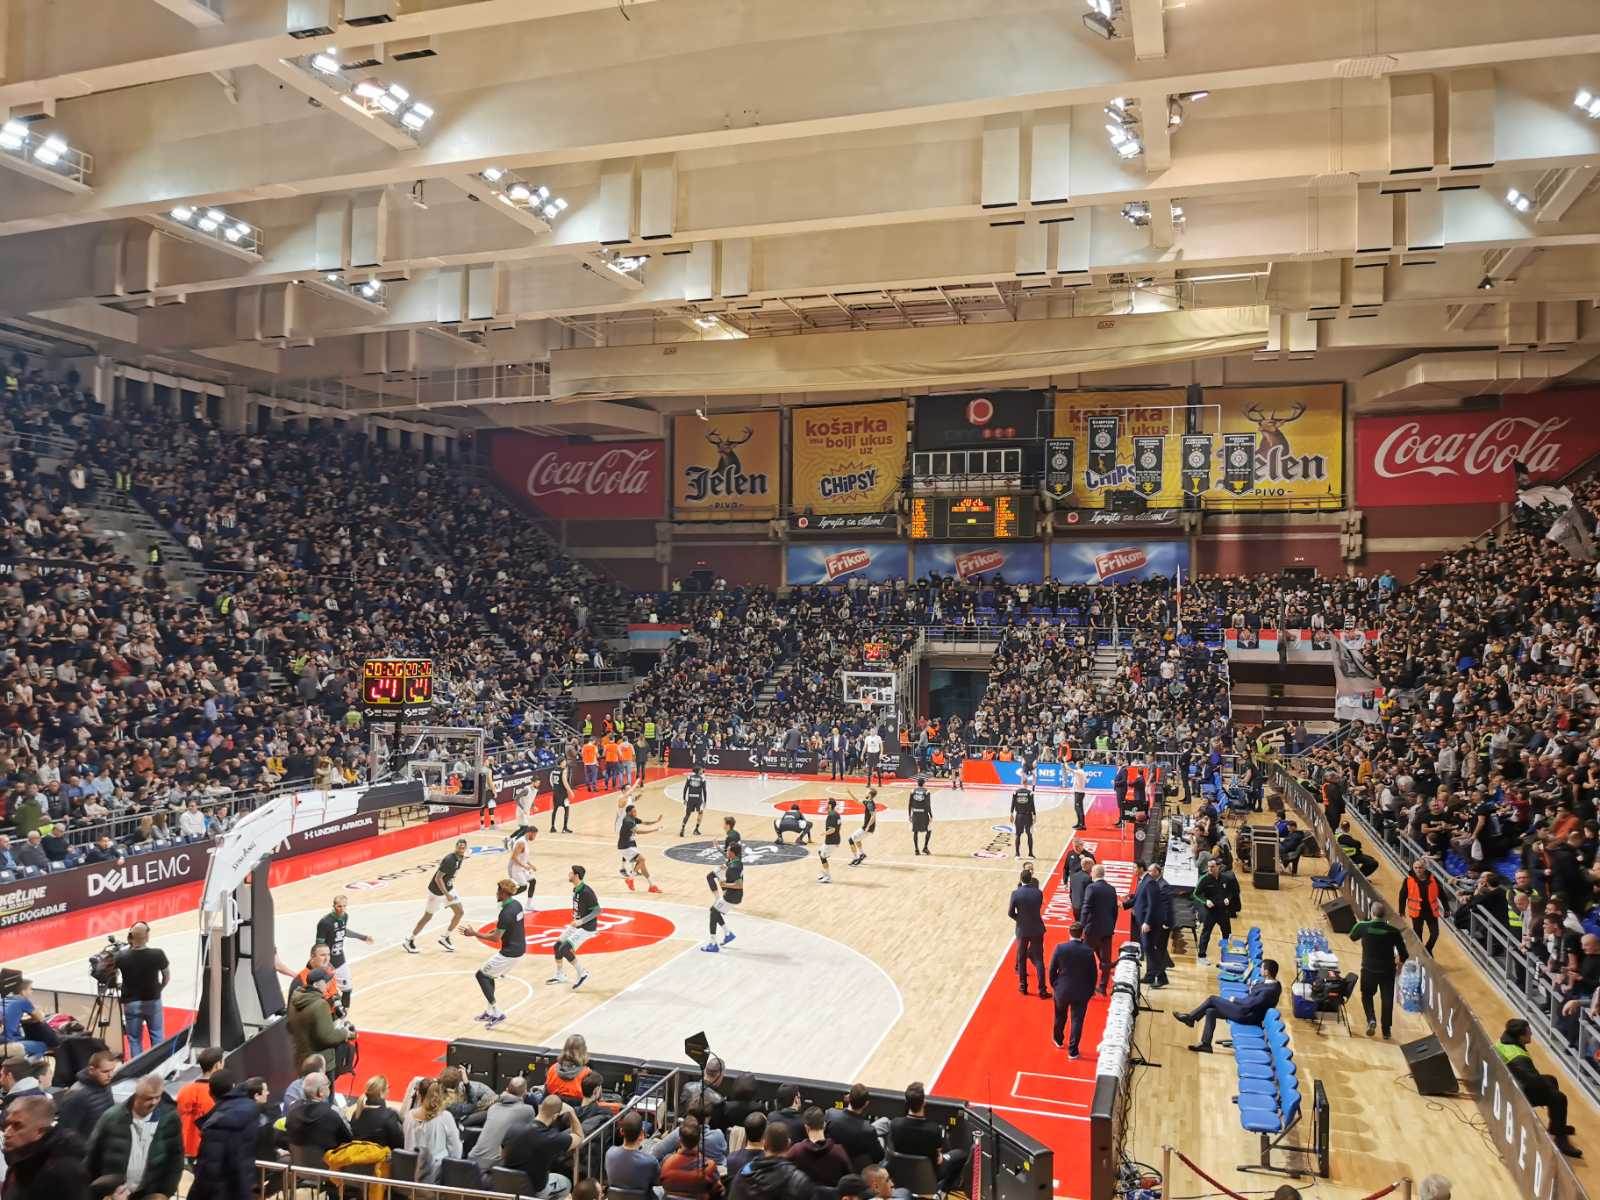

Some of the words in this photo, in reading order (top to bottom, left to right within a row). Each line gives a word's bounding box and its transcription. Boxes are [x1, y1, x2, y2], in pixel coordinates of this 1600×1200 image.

[805, 416, 888, 437] košarka
[1131, 424, 1169, 436] ukus
[825, 436, 856, 449] bolji
[860, 435, 893, 447] ukus
[1374, 416, 1571, 478] Coca-Cola
[527, 449, 656, 496] Coca-Cola
[685, 464, 768, 502] Jelen
[1255, 488, 1285, 496] PIVO
[365, 662, 403, 676] 20:20
[1039, 769, 1056, 777] NIS
[314, 825, 341, 837] UNDER
[341, 817, 373, 830] ARMOUR
[0, 913, 19, 926] SVE
